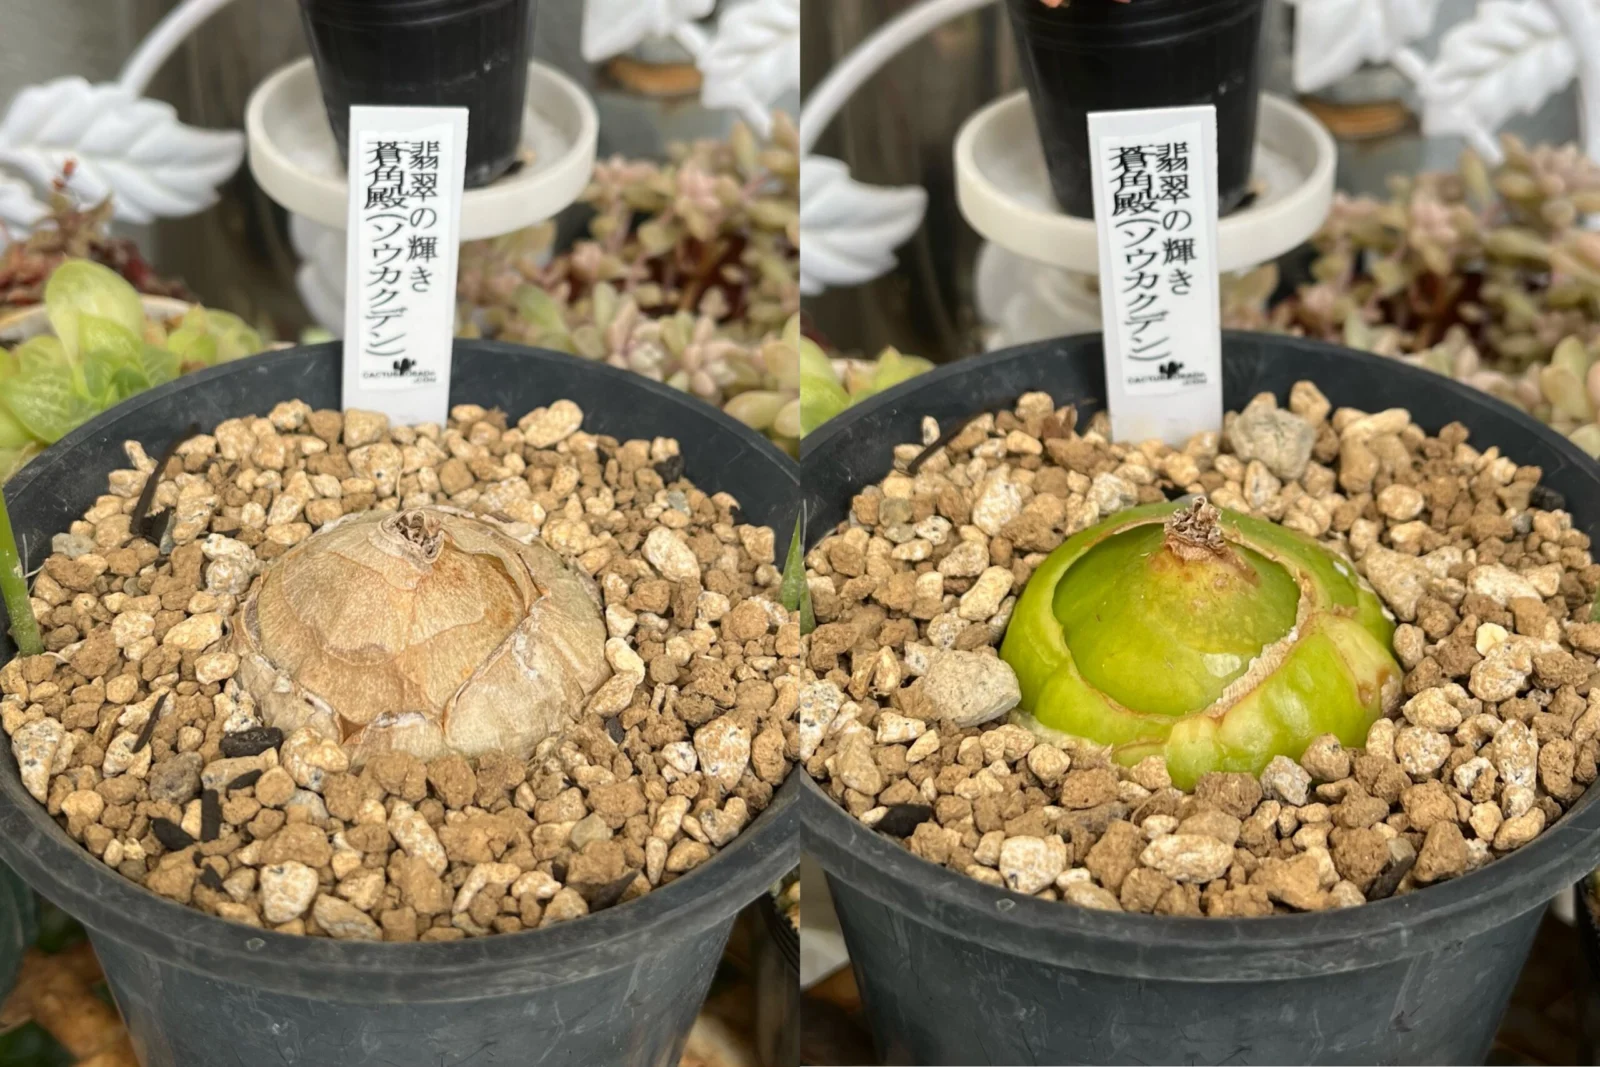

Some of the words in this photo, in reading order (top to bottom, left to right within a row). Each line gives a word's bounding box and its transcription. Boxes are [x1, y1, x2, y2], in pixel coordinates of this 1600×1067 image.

[405, 140, 440, 293] 翡翠の輝き
[1155, 141, 1197, 295] 翡翠の輝き
